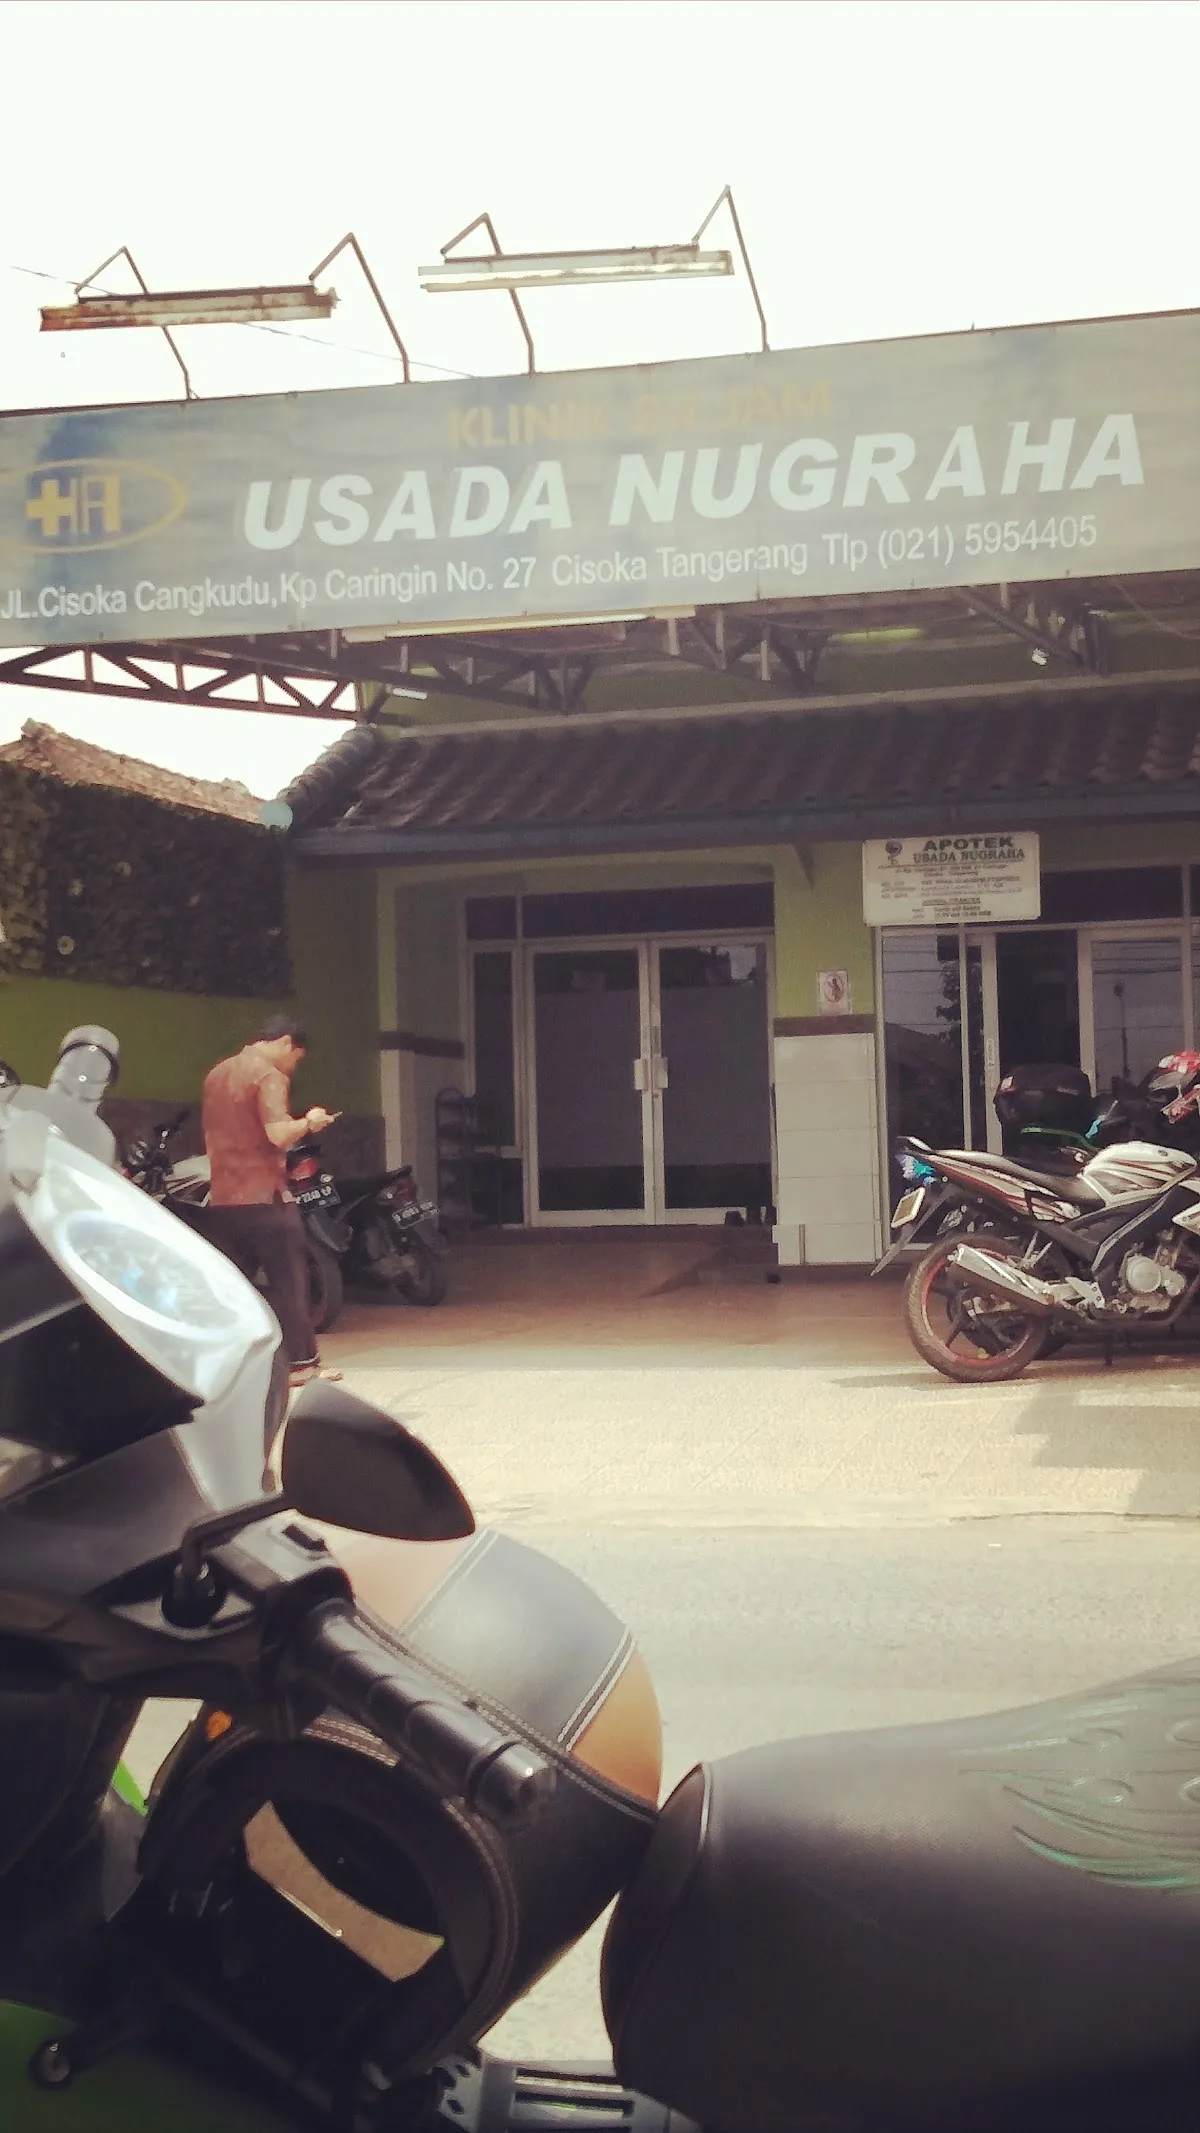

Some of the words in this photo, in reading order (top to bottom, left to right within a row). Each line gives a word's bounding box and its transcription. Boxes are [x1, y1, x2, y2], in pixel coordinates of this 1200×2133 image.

[243, 460, 572, 550] USADA
[609, 413, 1145, 526] NUGRAHA
[325, 564, 437, 602] Caringin
[447, 561, 493, 593] No.
[503, 556, 537, 589] 27
[552, 551, 647, 586] Cisoka
[656, 546, 808, 582] Tangerang
[821, 532, 868, 571] Tlp
[879, 525, 954, 569] (021)
[965, 514, 1097, 556] 5954405
[923, 836, 1013, 851] APOTEK
